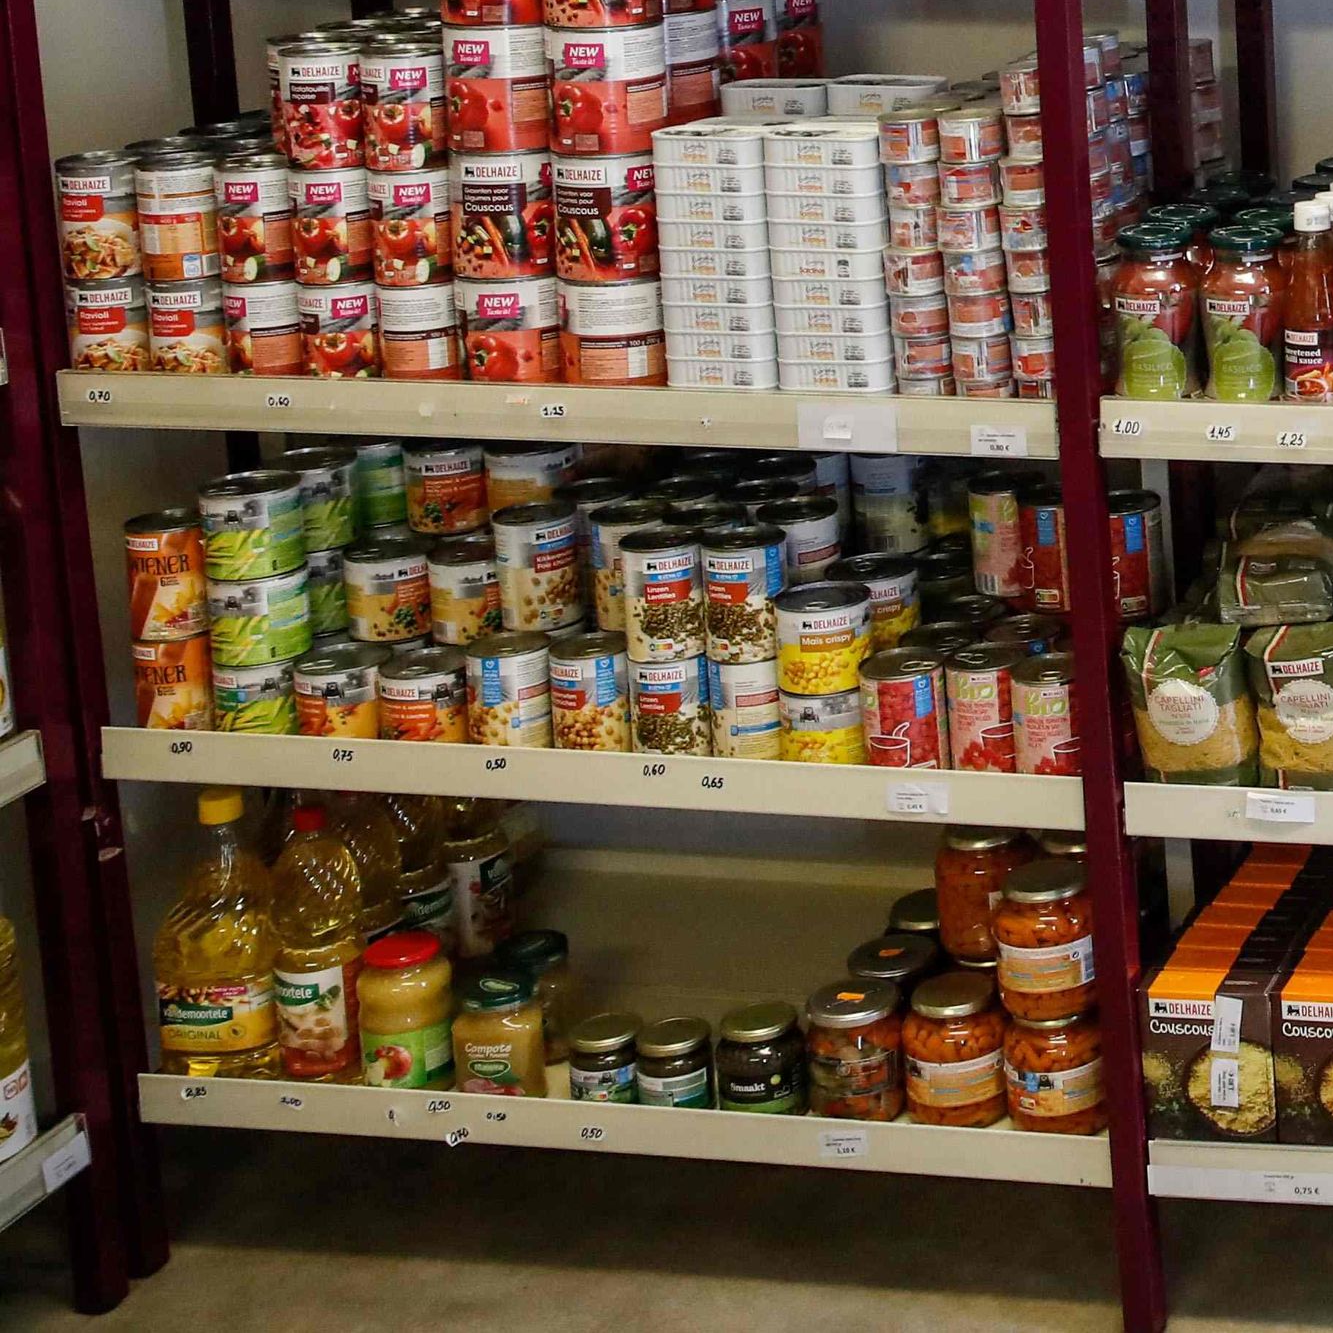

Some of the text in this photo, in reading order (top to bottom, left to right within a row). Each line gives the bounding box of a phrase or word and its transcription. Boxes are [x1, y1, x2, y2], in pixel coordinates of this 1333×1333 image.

[458, 45, 483, 54] NEW
[394, 70, 423, 82] NEW
[475, 166, 518, 177] DELHAIZE
[70, 176, 107, 191] DELHAIZE
[465, 203, 514, 212] Couscous
[482, 296, 513, 310] NEW
[1114, 421, 1140, 433] 1,00
[1210, 426, 1231, 438] 1,45
[1280, 435, 1303, 446] 1,25
[647, 587, 668, 595] Linzen
[813, 617, 847, 630] DELHAIZE
[802, 636, 850, 646] Maïs crispy
[1282, 660, 1321, 676] DELHAIZE
[172, 742, 192, 752] 0,90
[333, 750, 353, 760] 0,75
[486, 759, 505, 769] 0,50
[643, 765, 664, 775] 0,60
[702, 777, 723, 789] 0,65
[1169, 1002, 1212, 1017] DELHAIZE
[1150, 1020, 1214, 1036] Couscous
[581, 1128, 602, 1139] 0,50
[1294, 1187, 1312, 1195] 0,75
